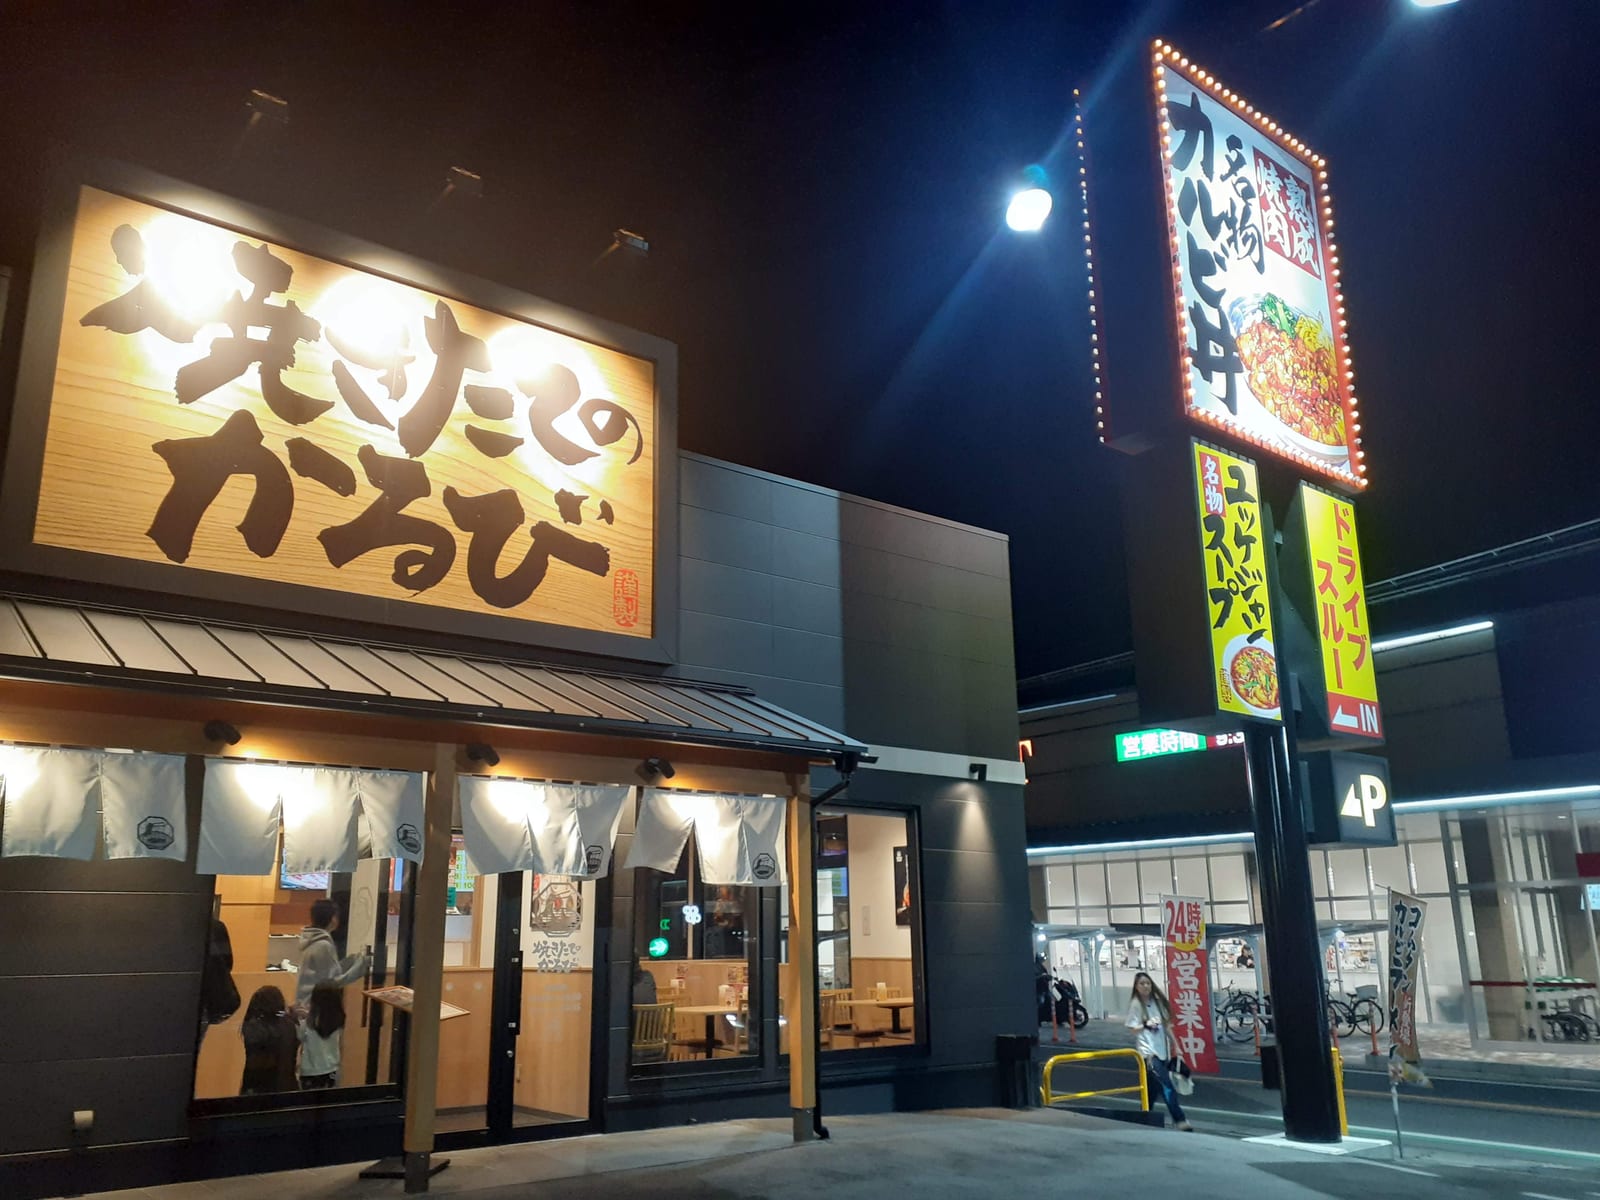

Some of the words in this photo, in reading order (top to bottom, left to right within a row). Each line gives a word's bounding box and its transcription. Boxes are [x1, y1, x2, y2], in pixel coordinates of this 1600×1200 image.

[1168, 91, 1243, 415] カルビ丼
[1220, 134, 1265, 275] 名物
[1257, 158, 1291, 258] 焼肉
[79, 223, 642, 465] 焼きたての
[145, 409, 614, 609] かるび
[1205, 455, 1224, 515] 名物
[1203, 513, 1240, 629] スープ
[1224, 465, 1268, 645] ユッケジャン
[1333, 502, 1367, 671] ドライブ
[1316, 559, 1344, 690] スルー
[1122, 729, 1199, 759] 営業時間
[1359, 703, 1379, 734] IN
[1360, 774, 1387, 827] P
[1171, 951, 1207, 1070] 営業中
